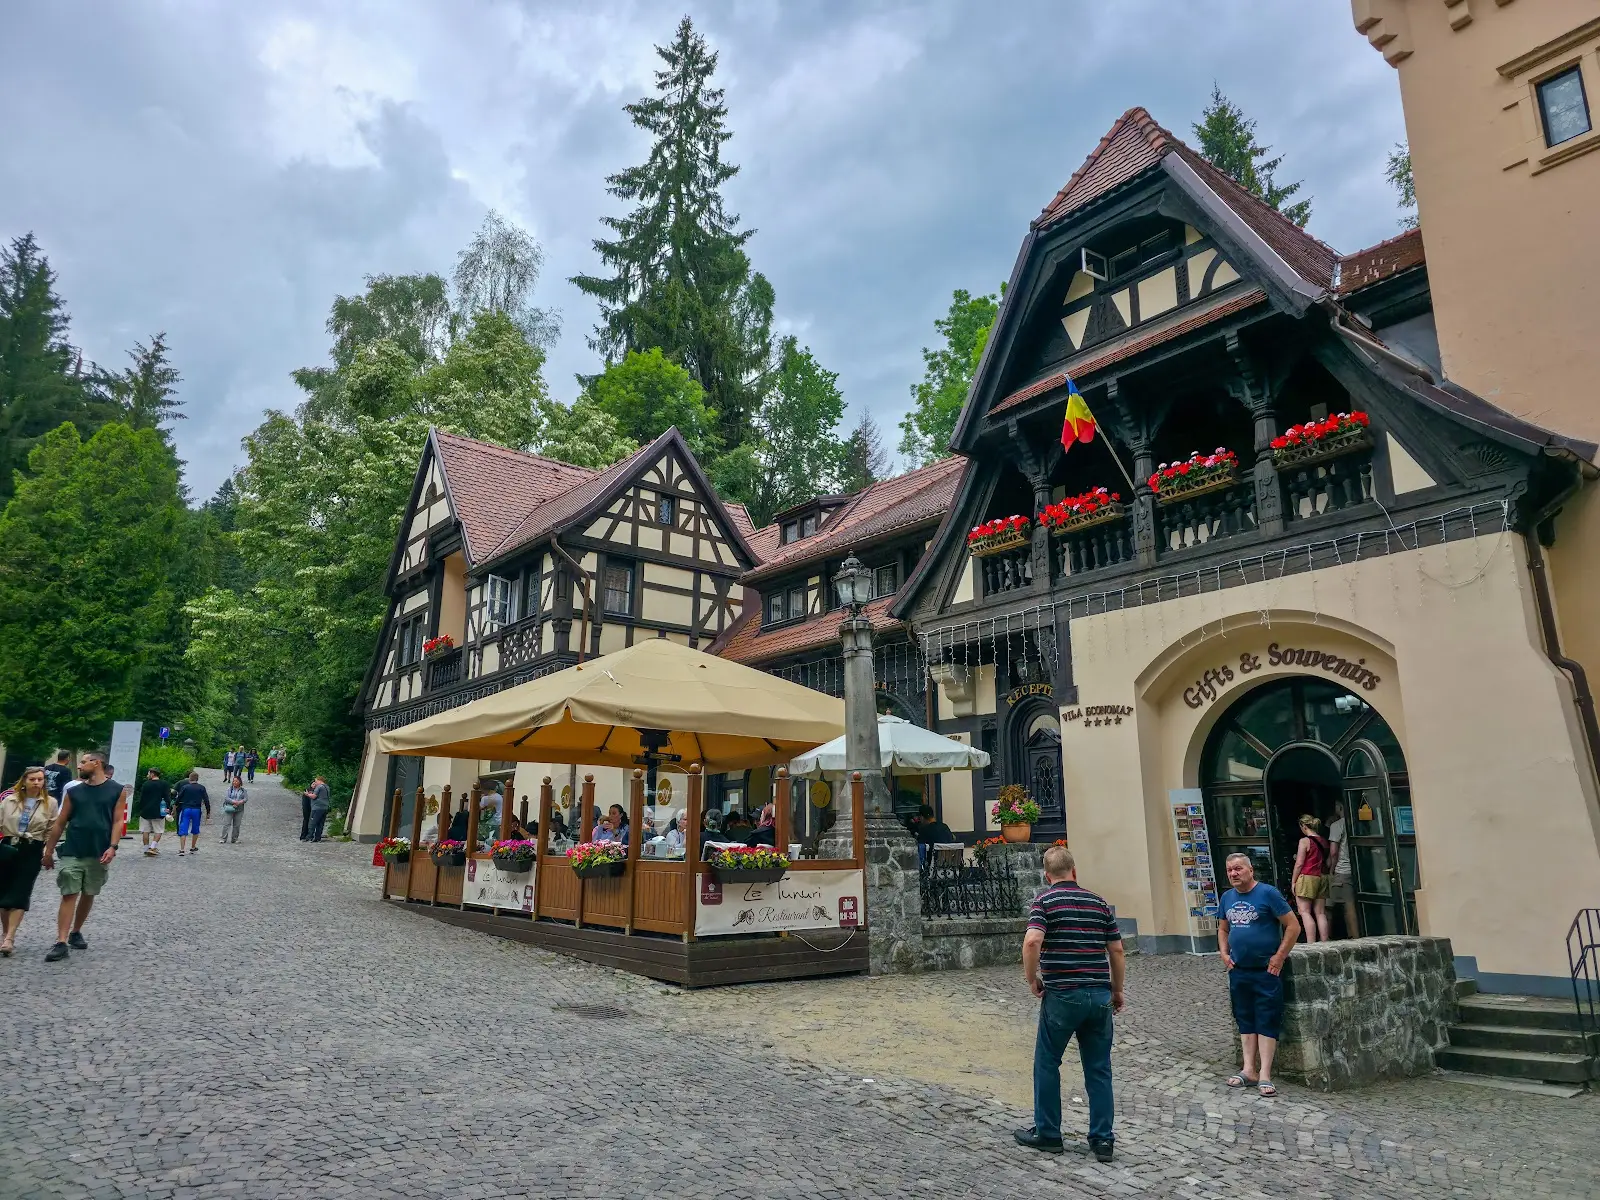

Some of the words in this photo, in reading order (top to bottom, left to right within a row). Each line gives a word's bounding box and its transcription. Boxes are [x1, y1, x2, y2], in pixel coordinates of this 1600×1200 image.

[1182, 664, 1235, 710] Gifts
[1239, 652, 1262, 675] &
[1267, 642, 1382, 692] Souvenirs
[1062, 707, 1083, 722] VILA
[1085, 704, 1134, 717] ECONOMAT
[758, 906, 811, 923] Restaurant
